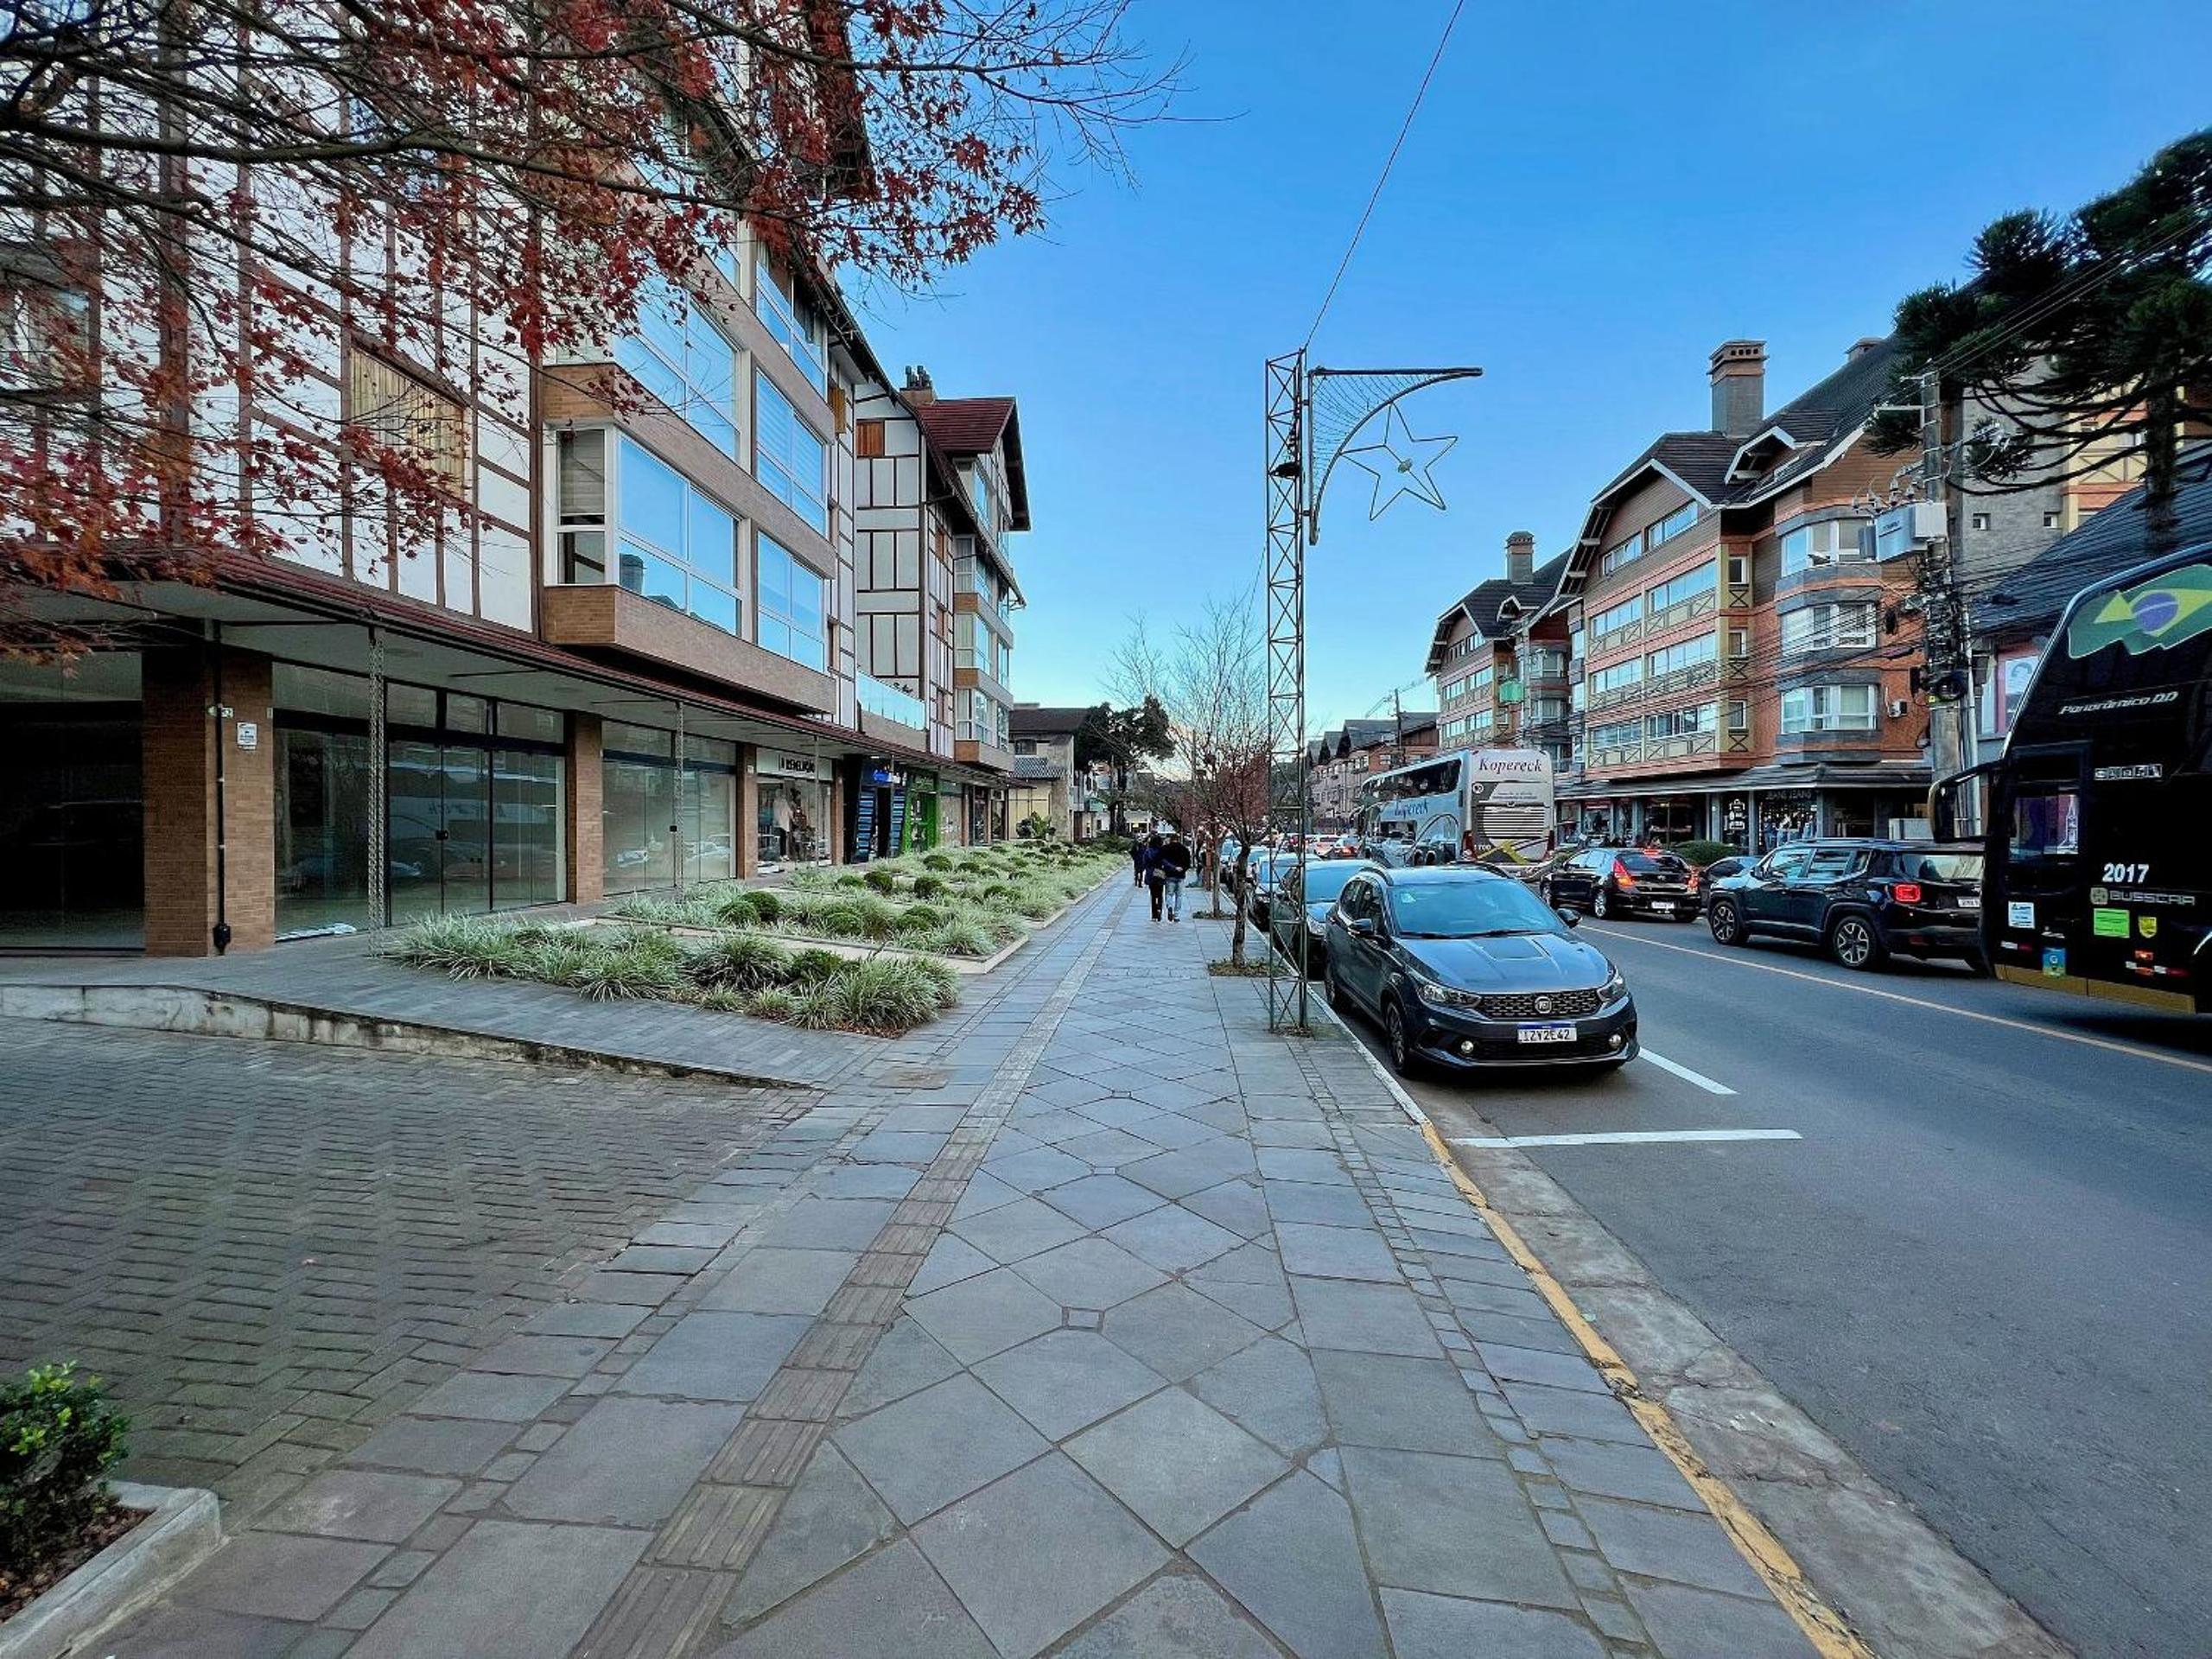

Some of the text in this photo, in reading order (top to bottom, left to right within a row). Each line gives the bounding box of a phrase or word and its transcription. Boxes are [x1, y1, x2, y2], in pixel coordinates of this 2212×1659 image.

[1479, 759, 1542, 775] Kopereck
[2101, 862, 2150, 884] 2017
[2109, 890, 2196, 906] BUSSCAR
